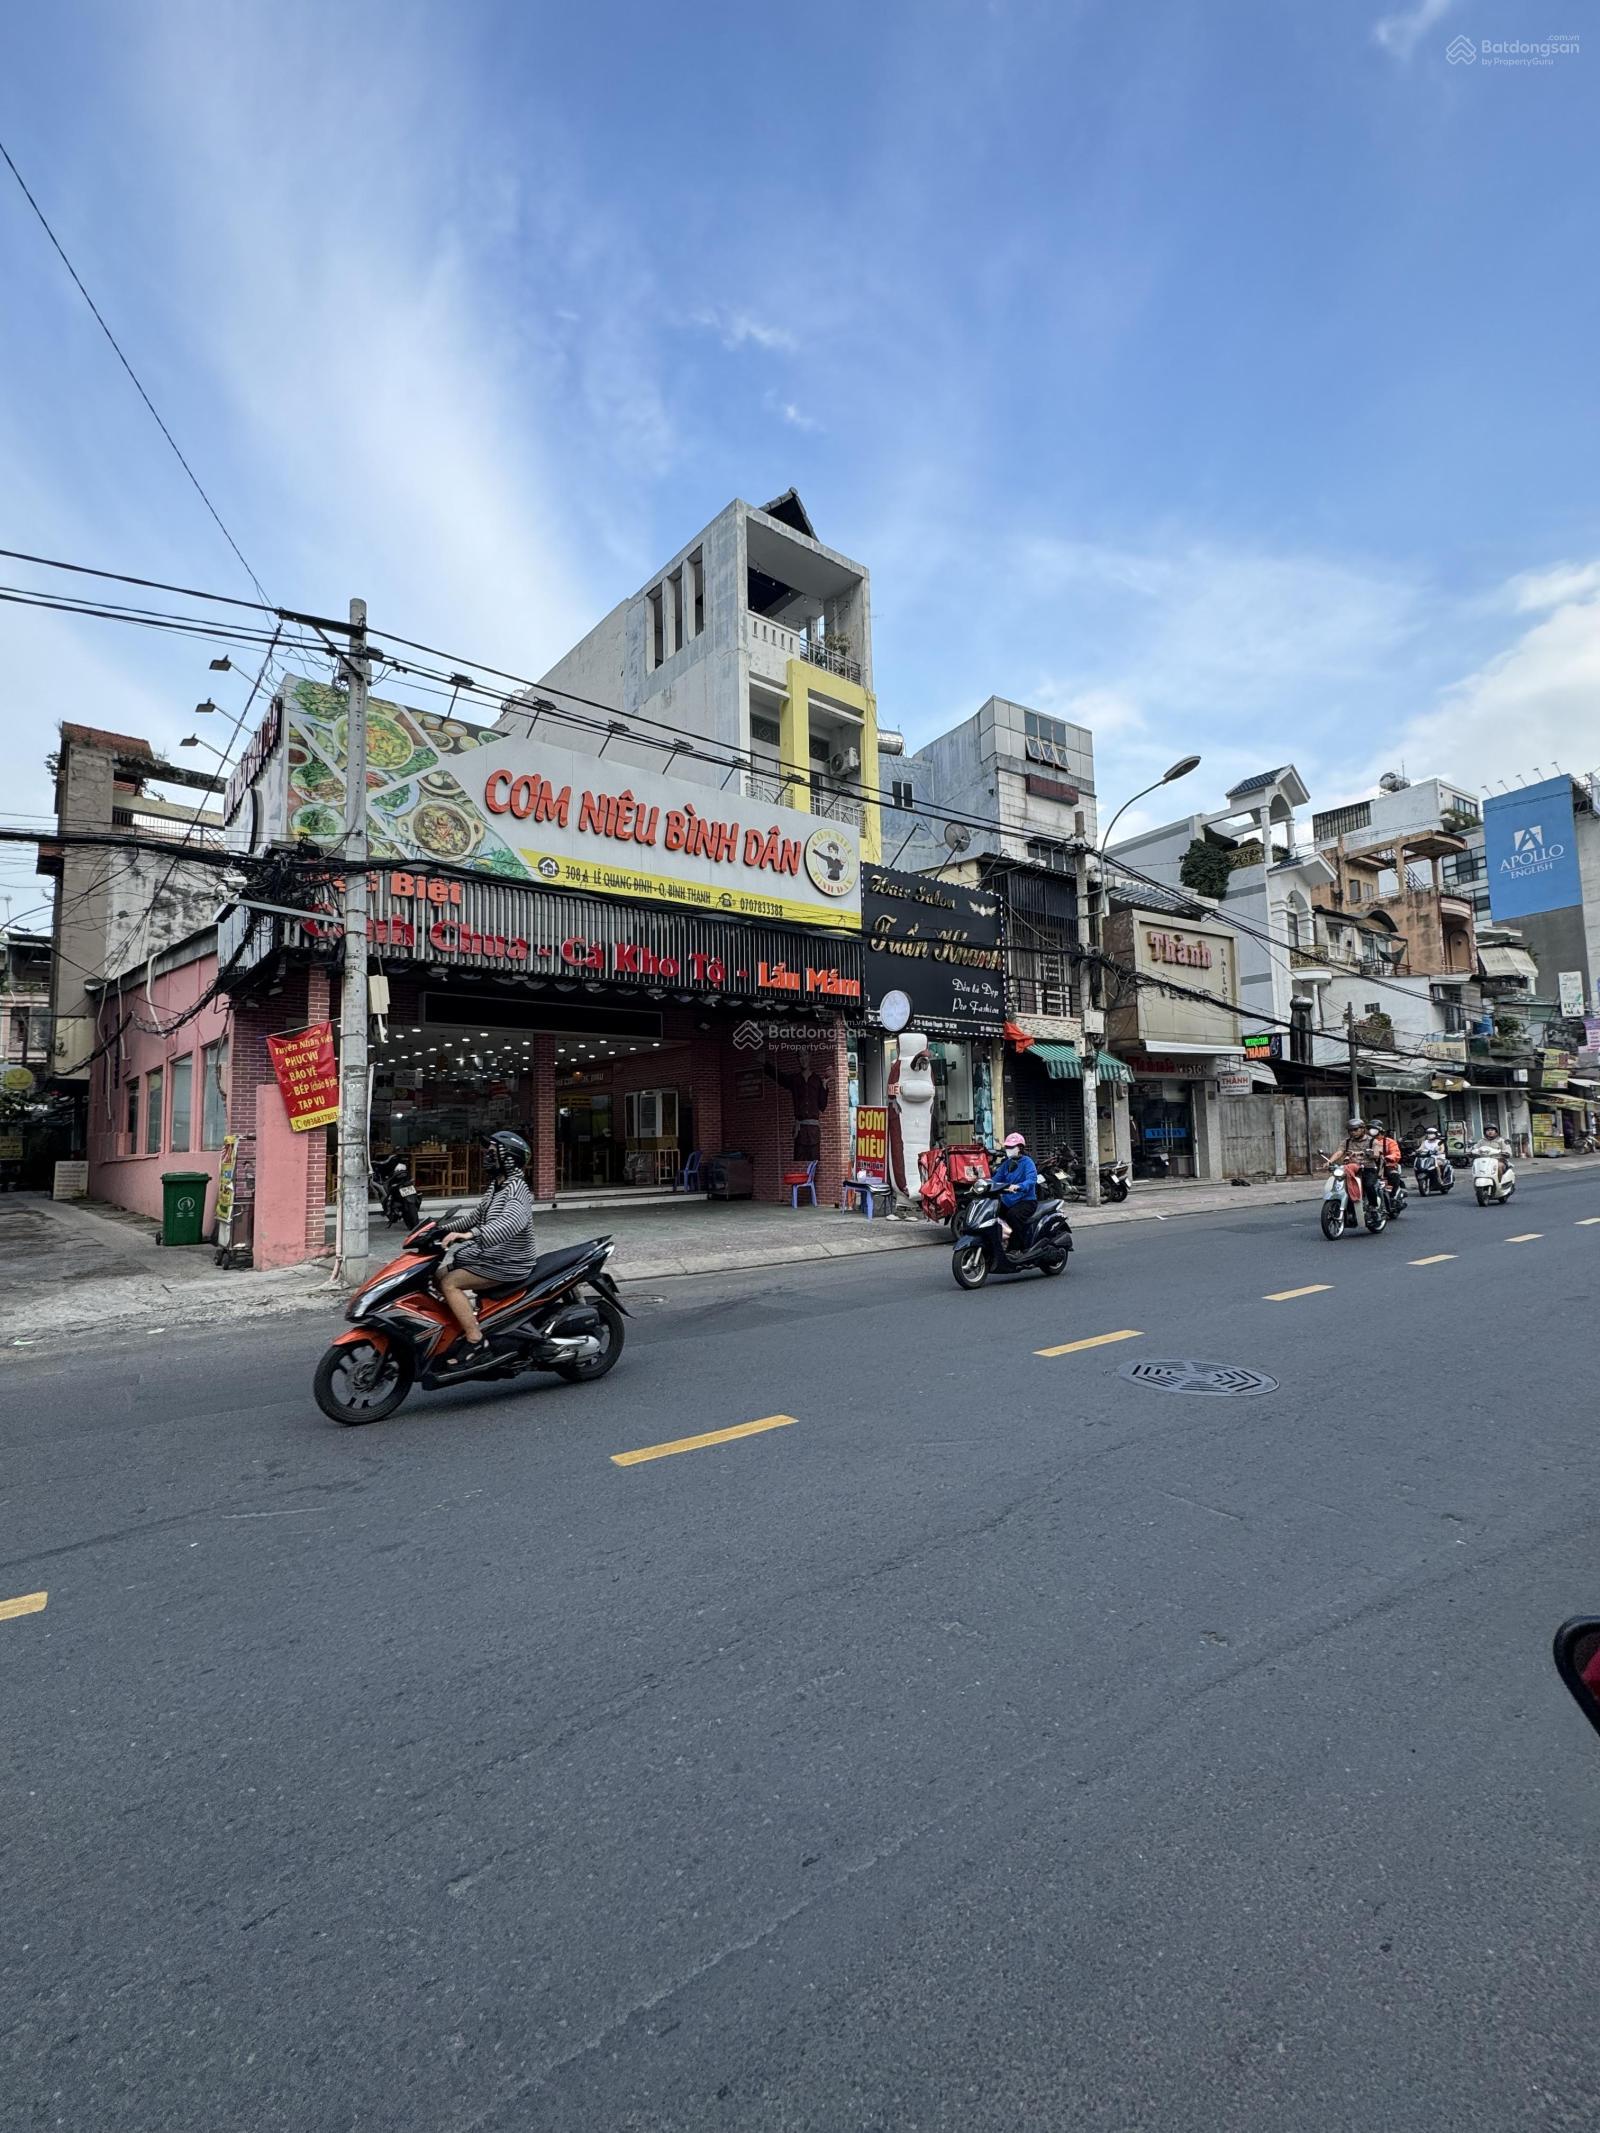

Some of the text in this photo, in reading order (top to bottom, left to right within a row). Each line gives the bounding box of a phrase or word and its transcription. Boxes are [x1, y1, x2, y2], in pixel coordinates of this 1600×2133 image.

[485, 769, 801, 876] CƠM NIÊU BÌNH DÂN
[1500, 844, 1564, 872] APOLLO
[1510, 862, 1554, 880] ENGLISH
[390, 872, 462, 907] Biệt
[565, 865, 581, 881] 308
[603, 872, 633, 890] QUANG
[871, 874, 956, 909] Hair Salon
[740, 897, 784, 917] 0707833388
[430, 919, 529, 960] Chua
[614, 942, 679, 977] Kho
[688, 952, 726, 989] Tộ
[805, 967, 860, 997] Mắm
[858, 1109, 885, 1131] CƠM
[857, 1135, 885, 1159] NIÊU
